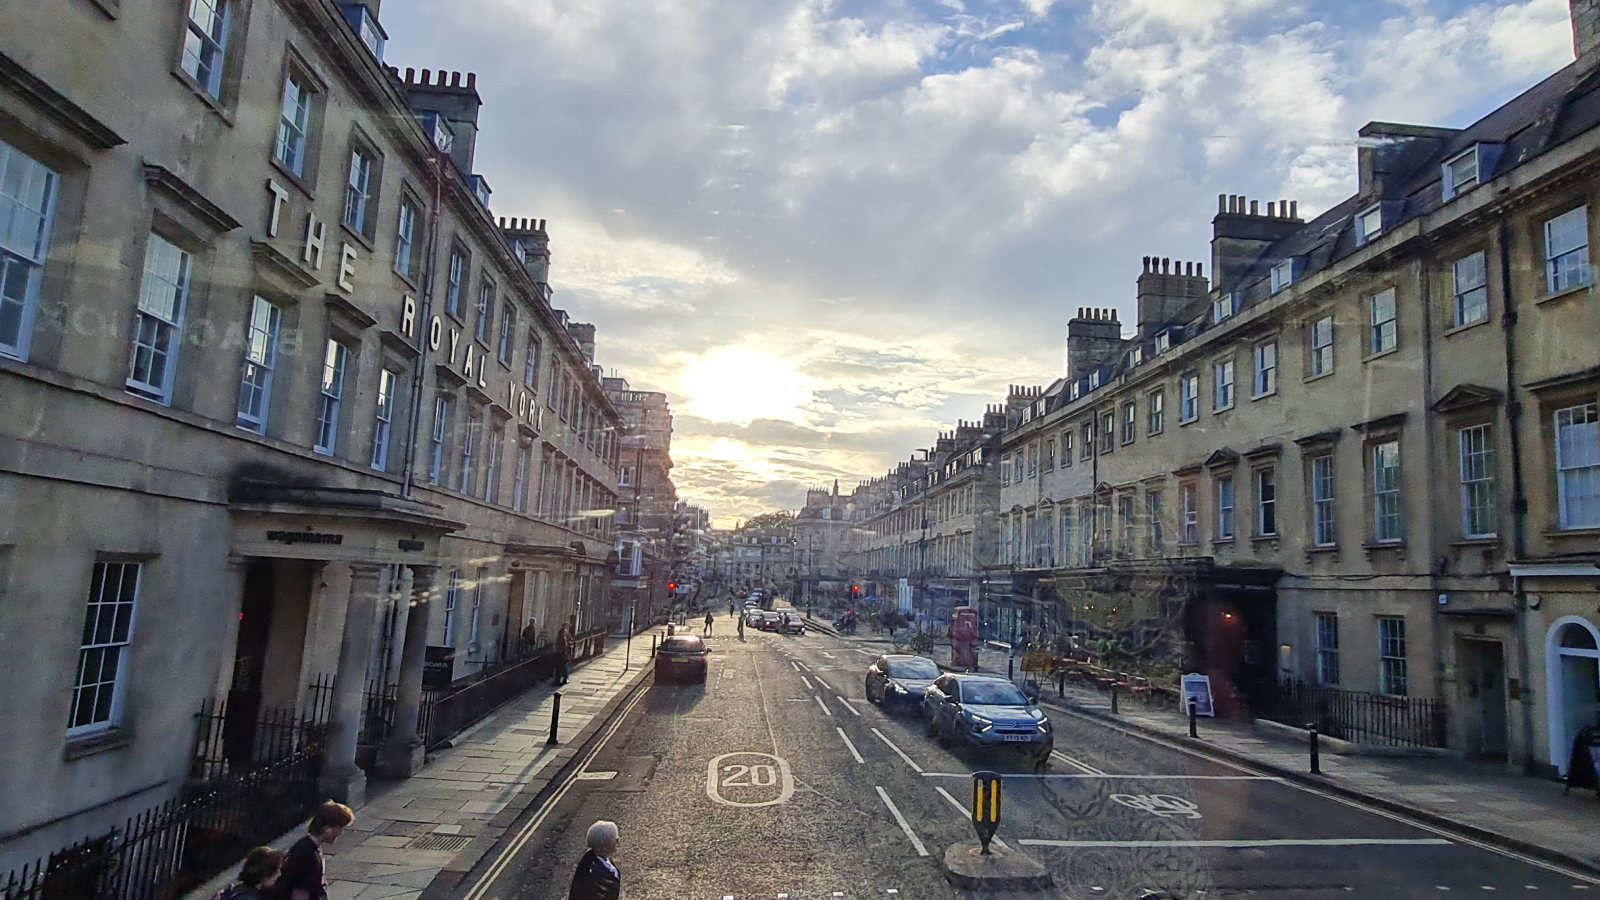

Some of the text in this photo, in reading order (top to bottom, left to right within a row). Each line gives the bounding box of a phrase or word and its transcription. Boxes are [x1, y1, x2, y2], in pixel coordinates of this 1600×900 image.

[266, 178, 544, 432] THE ROYAL YORK
[722, 765, 777, 787] 20
